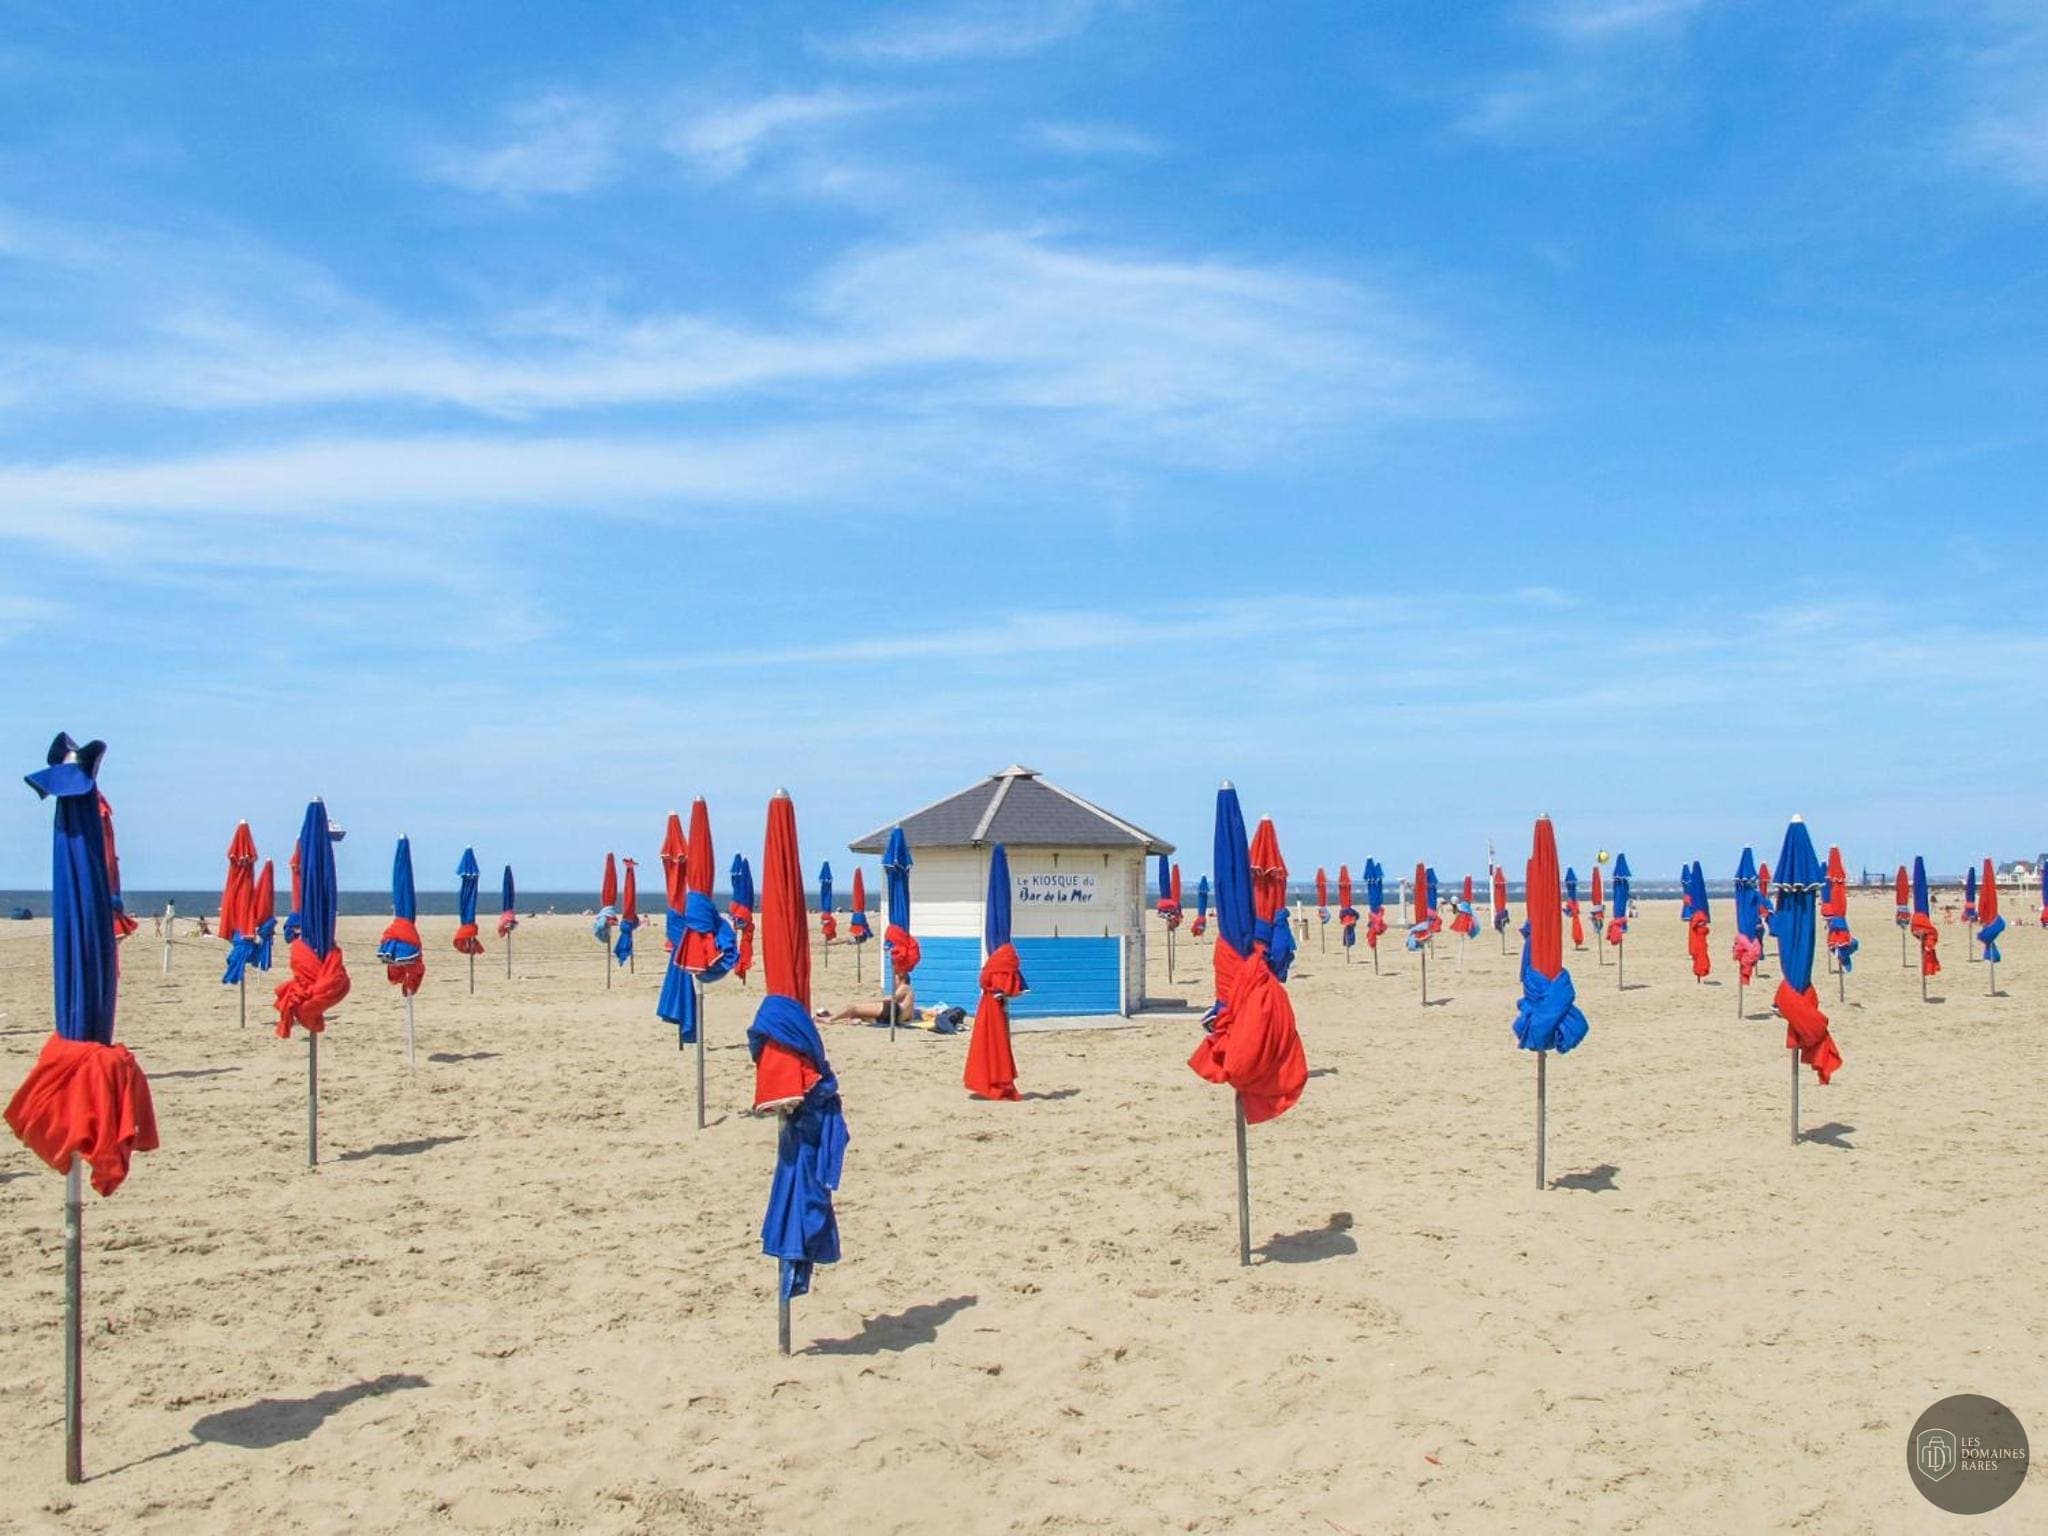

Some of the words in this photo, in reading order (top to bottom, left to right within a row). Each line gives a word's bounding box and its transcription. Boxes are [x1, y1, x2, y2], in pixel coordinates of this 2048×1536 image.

[1016, 877, 1028, 886] Le
[1032, 875, 1078, 887] KIOSQUE
[1082, 876, 1095, 886] du
[1020, 887, 1041, 902] Bar
[1044, 890, 1054, 902] de
[1057, 889, 1067, 902] la
[1070, 889, 1092, 903] Mer
